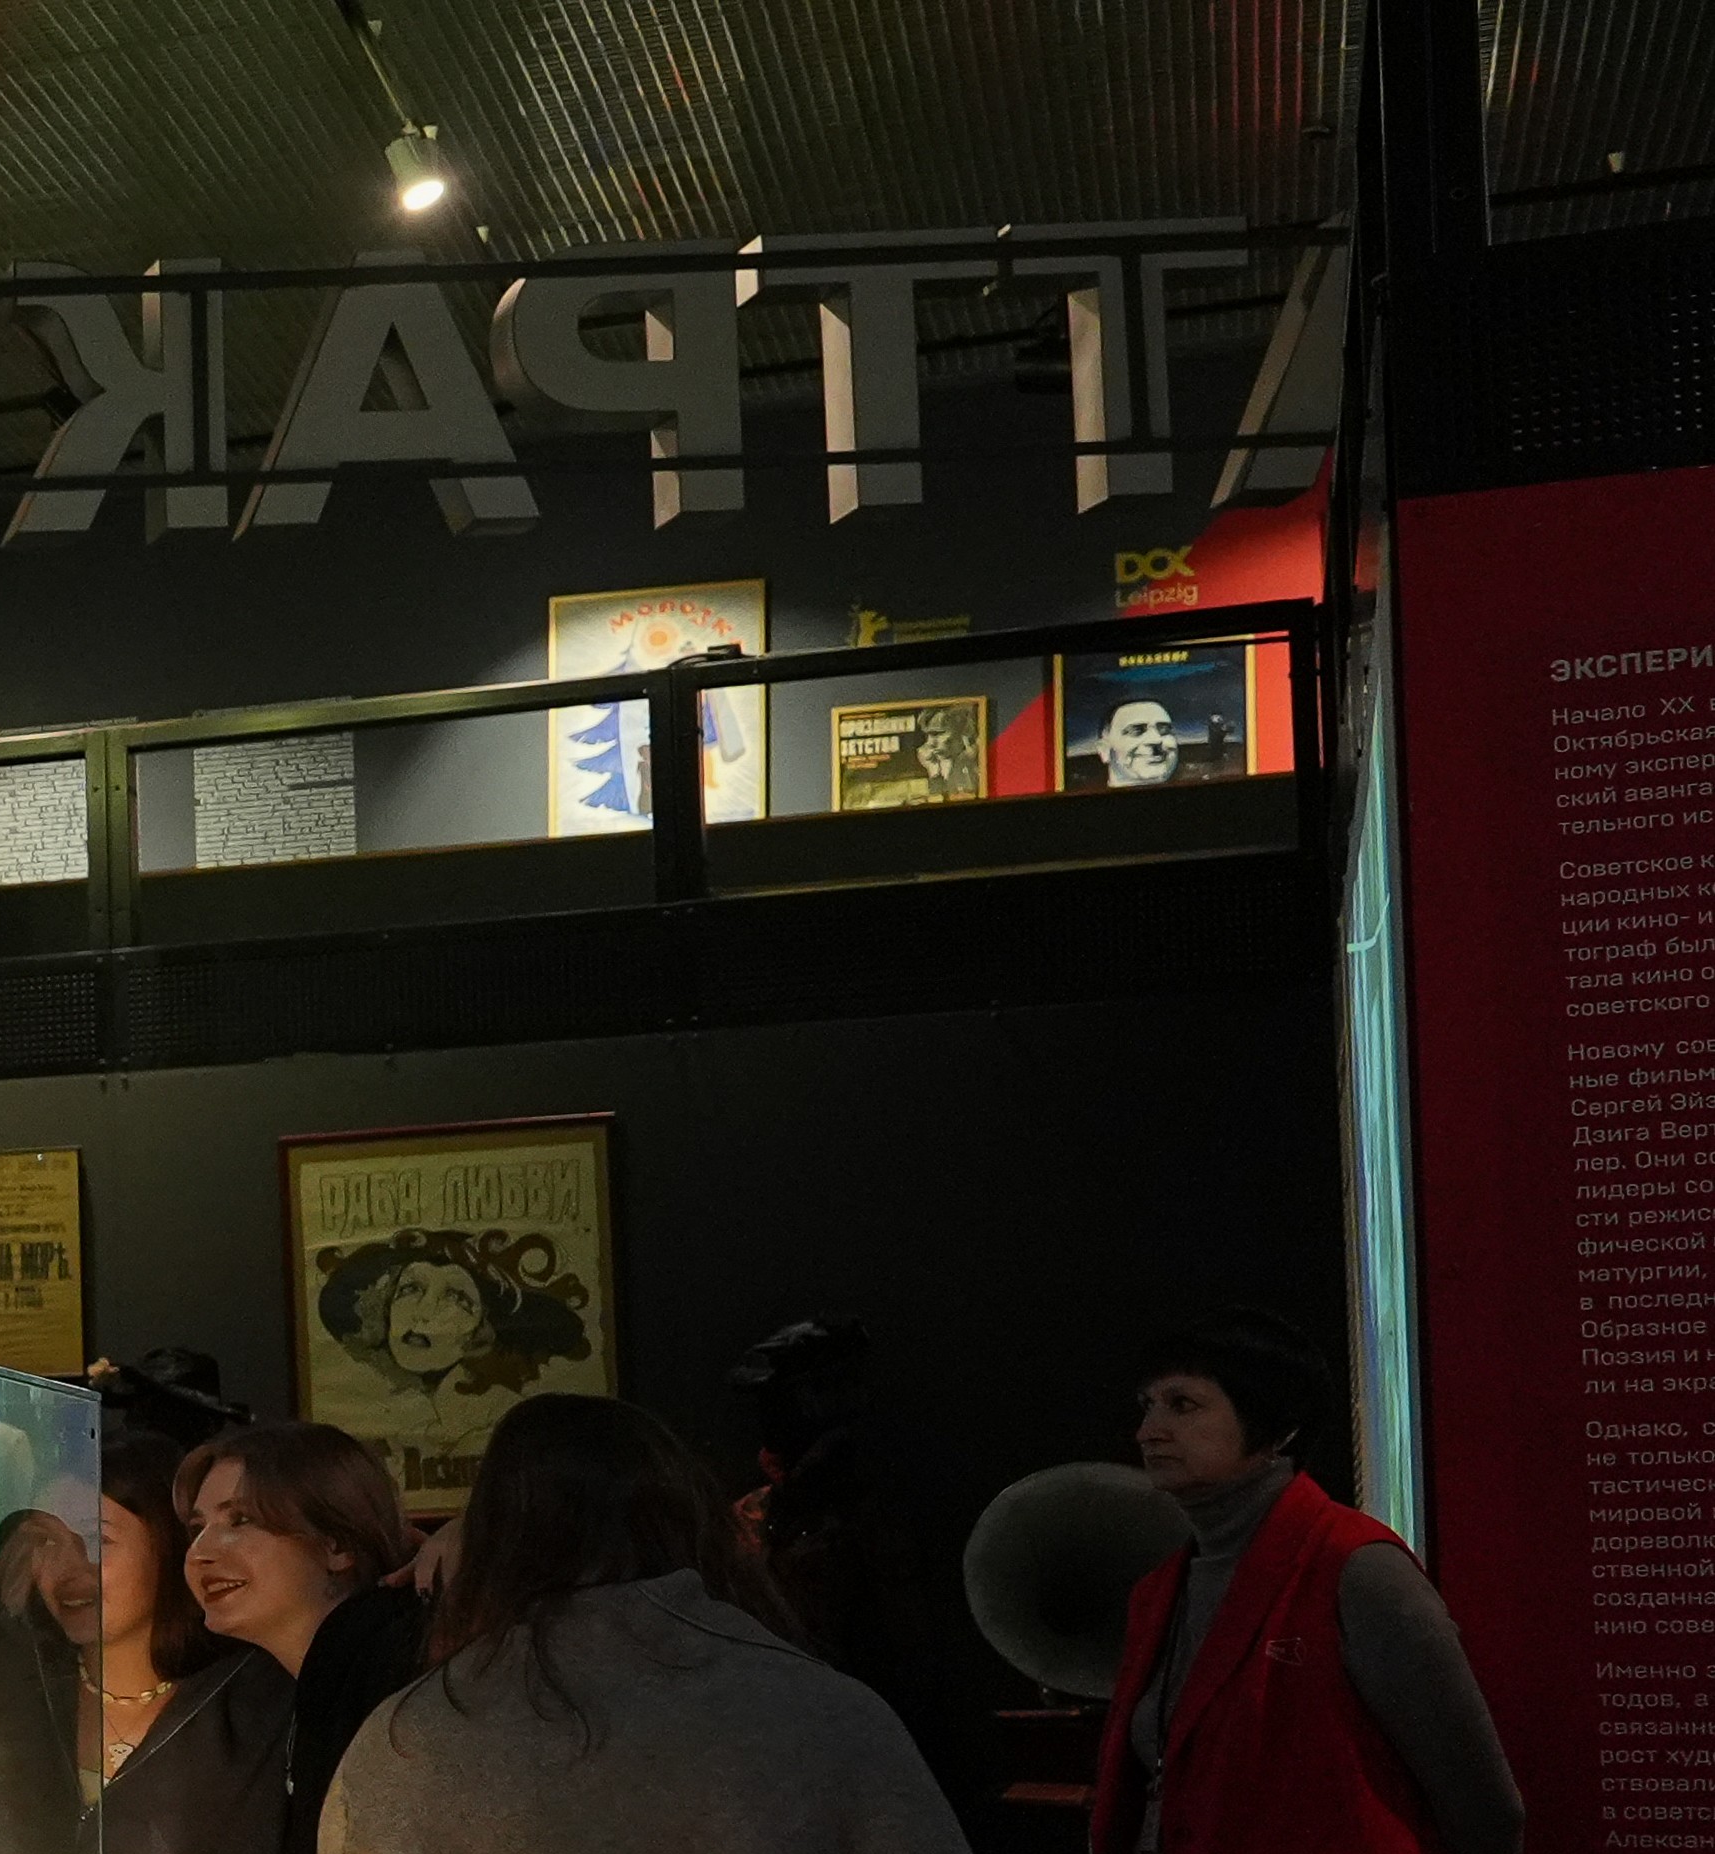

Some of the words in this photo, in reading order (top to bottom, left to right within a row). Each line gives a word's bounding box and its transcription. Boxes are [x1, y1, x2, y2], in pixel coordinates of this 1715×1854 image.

[1115, 583, 1198, 608] Leipzig
[1551, 704, 1645, 725] Начало
[1659, 695, 1694, 715] XX
[1554, 762, 1617, 780] ному
[1556, 785, 1616, 807] ский
[1558, 812, 1674, 834] тельного
[1559, 855, 1693, 879] Советское
[1560, 884, 1689, 907] народных
[1562, 918, 1609, 936] ции
[1617, 912, 1690, 930] кино-
[1563, 938, 1656, 961] тограф
[1564, 972, 1622, 989] тала
[1631, 967, 1692, 984] кино
[1565, 994, 1709, 1017] советского
[1567, 1042, 1664, 1060] Новому
[1571, 1094, 1662, 1118] Сергей
[1572, 1126, 1649, 1147] Дзига
[1574, 1156, 1625, 1172] лер.
[1635, 1150, 1684, 1168] Они
[320, 1172, 421, 1238] РАБА
[442, 1159, 581, 1224] ЛЮБВИ
[1577, 1231, 1705, 1257] фической
[1578, 1264, 1706, 1283] матургии,
[1581, 1319, 1706, 1340] Образное
[1582, 1348, 1675, 1365] Поэзия
[1585, 1420, 1687, 1440] Однако,
[1589, 1502, 1701, 1524] мировой
[1596, 1661, 1696, 1678] Именно
